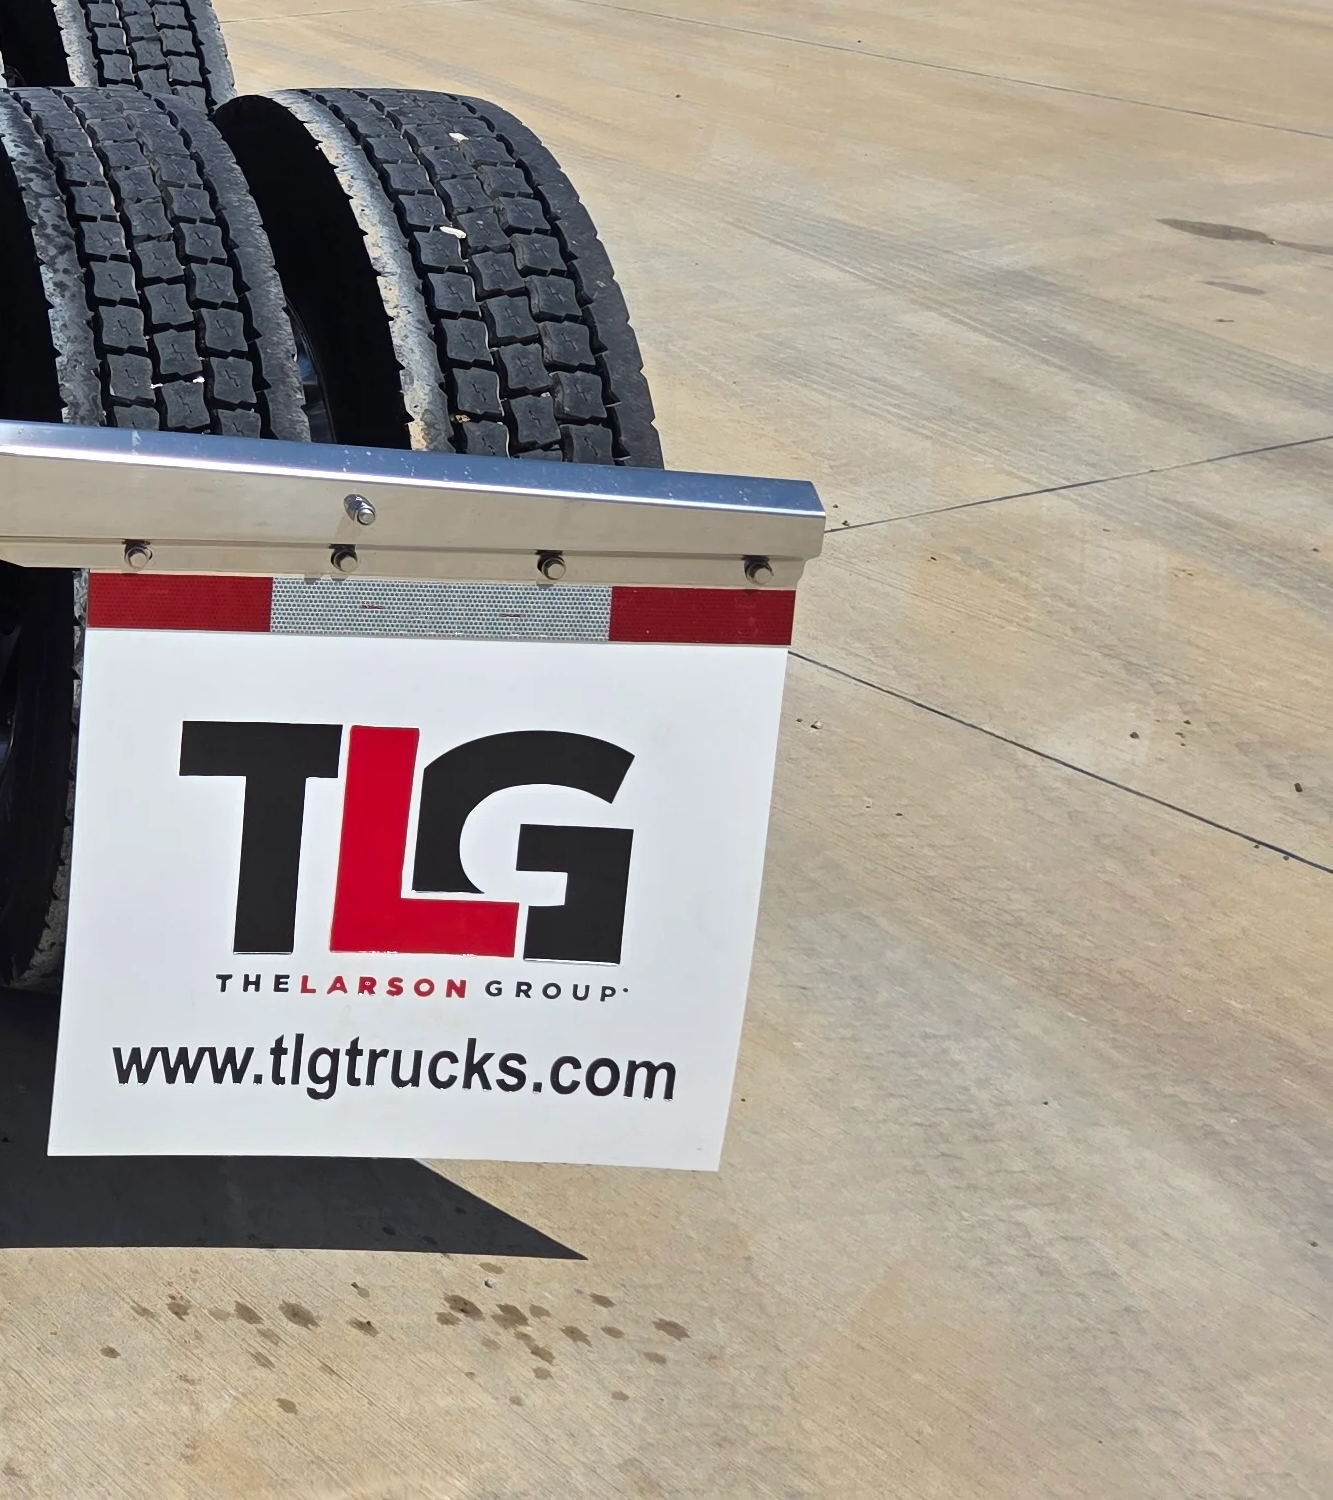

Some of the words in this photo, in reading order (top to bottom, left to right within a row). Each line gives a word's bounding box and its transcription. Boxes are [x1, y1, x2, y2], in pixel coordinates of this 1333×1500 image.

[179, 721, 636, 965] TLG
[484, 980, 617, 1003] GROUP
[112, 1033, 677, 1101] www.tlgtrucks.com
